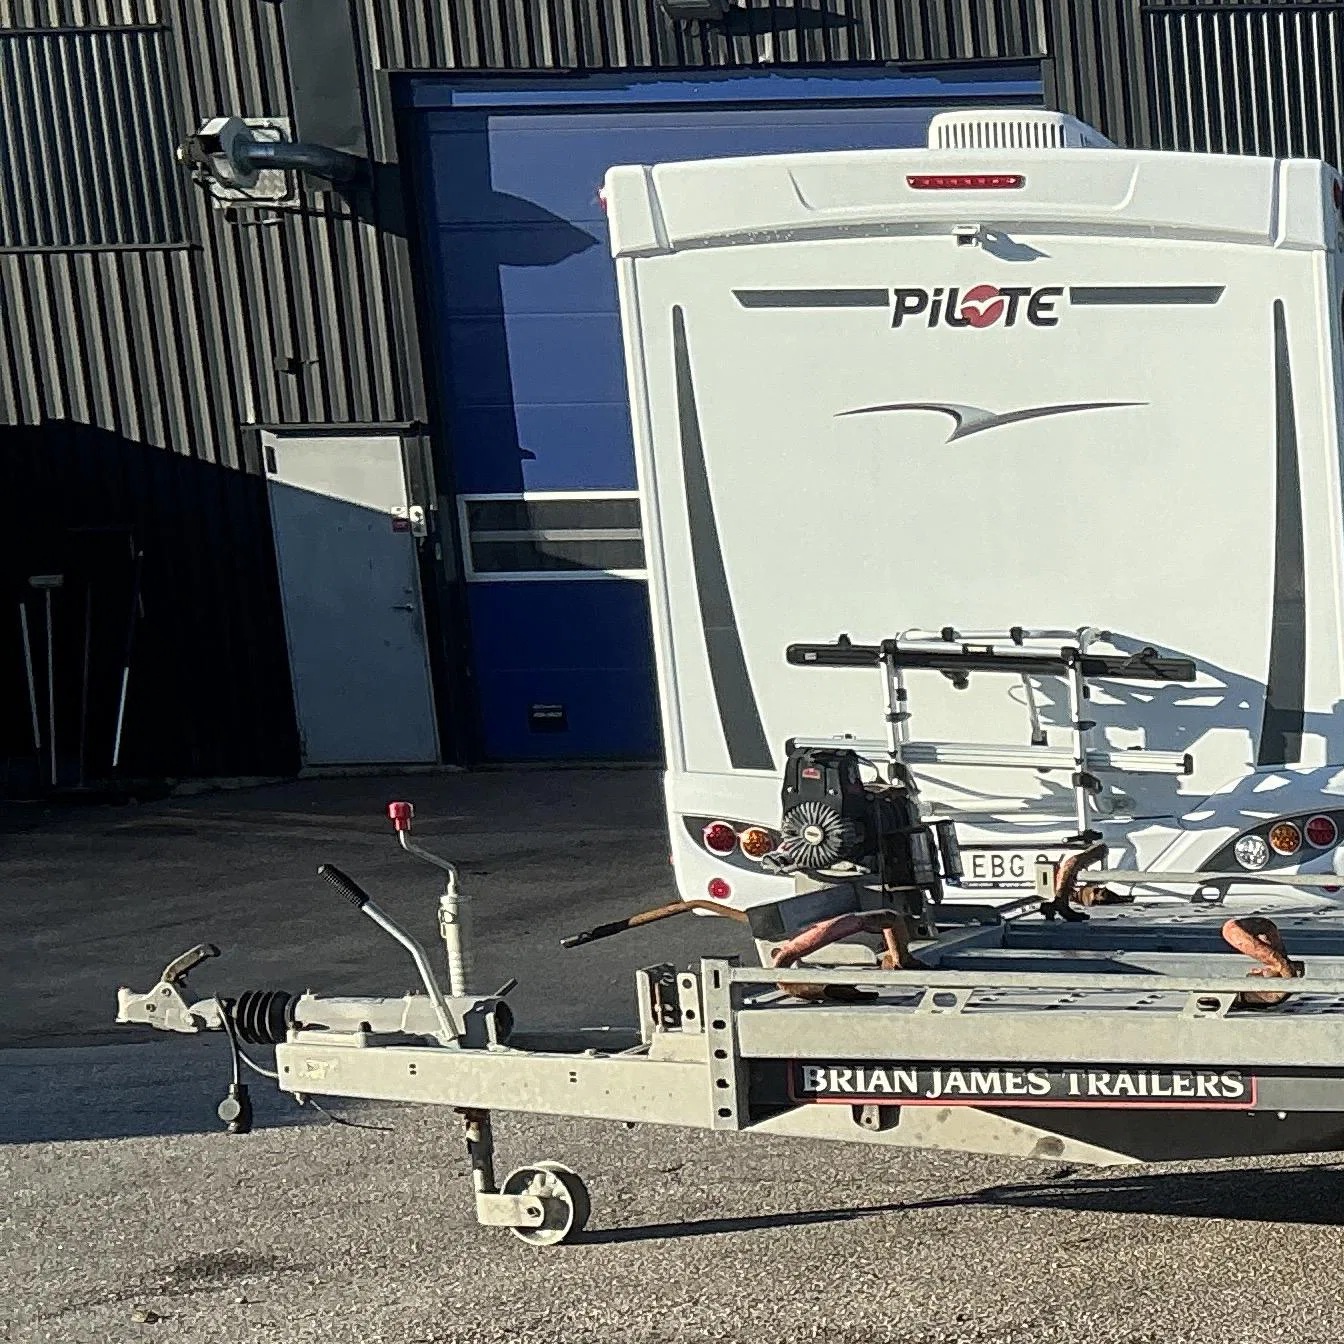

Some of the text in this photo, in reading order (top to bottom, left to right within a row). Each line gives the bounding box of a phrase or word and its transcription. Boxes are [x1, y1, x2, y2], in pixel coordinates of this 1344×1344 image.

[972, 854, 1025, 878] EBG
[803, 1065, 1245, 1099] BRIAN JAMES TRAILERS
